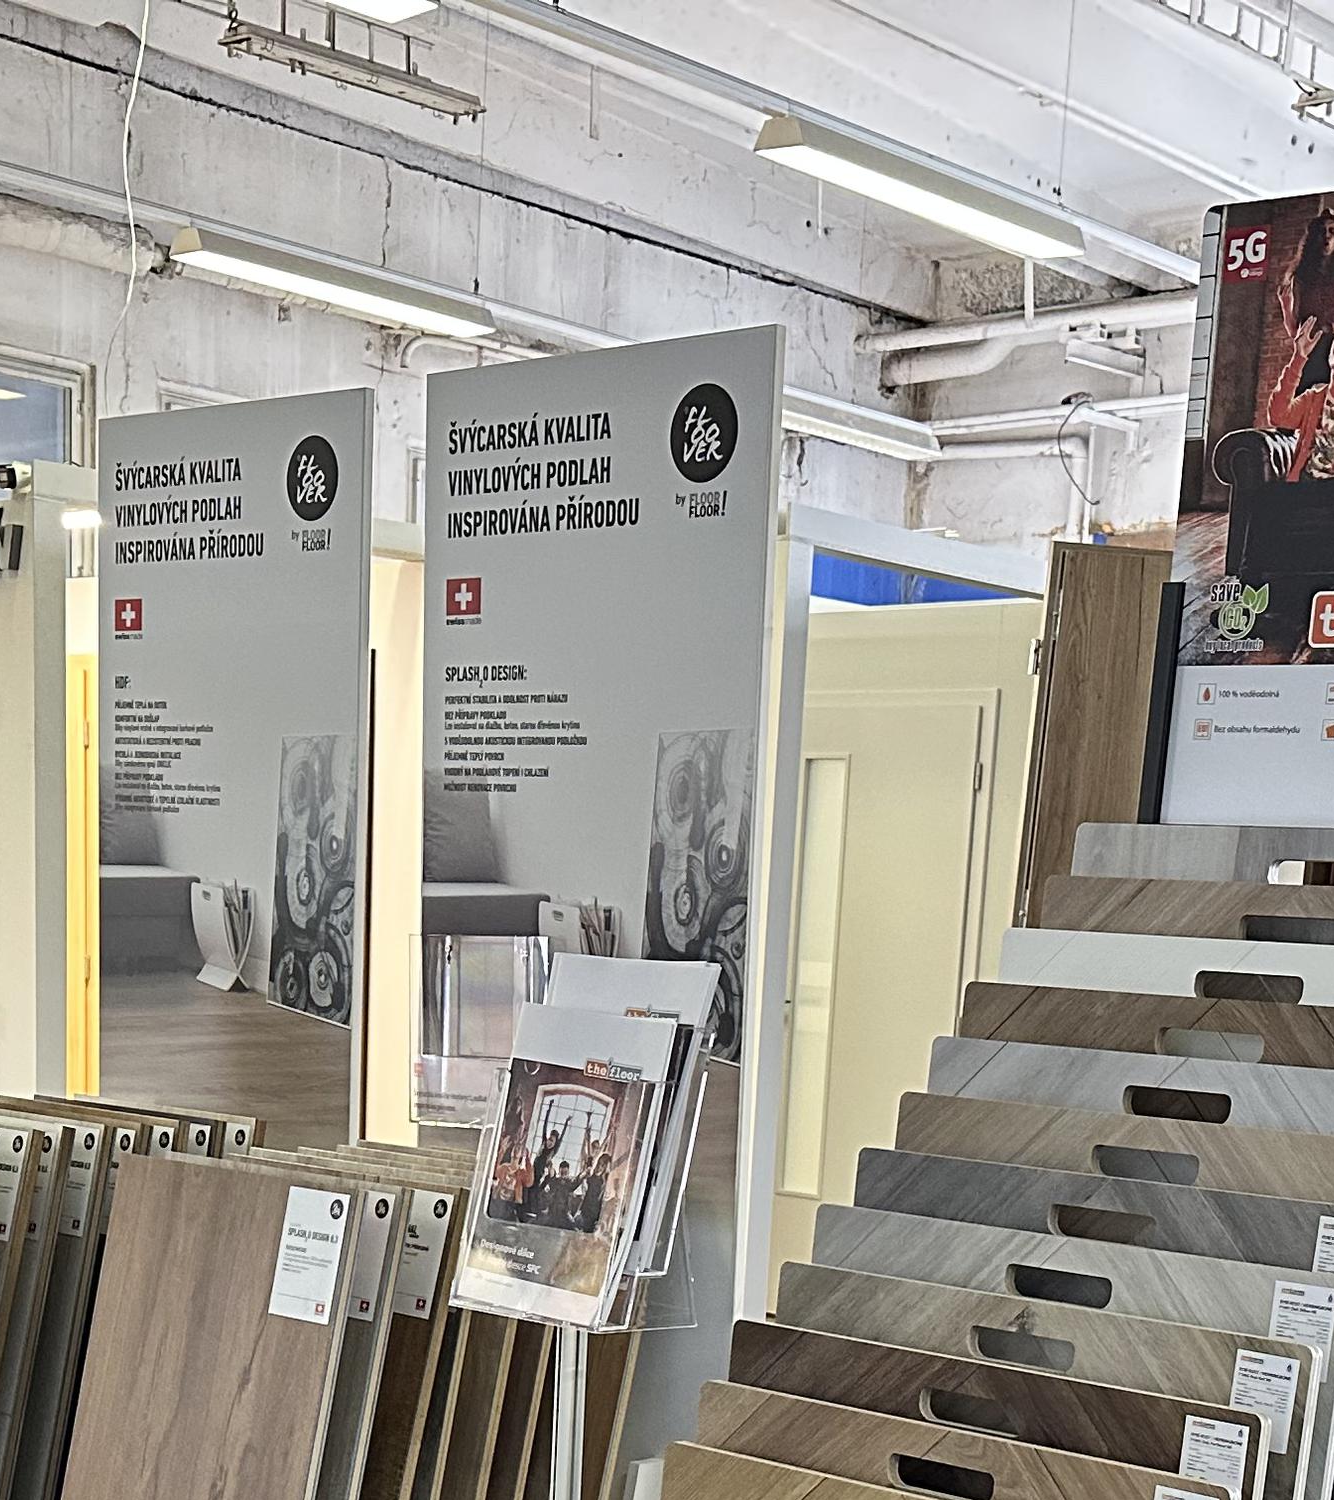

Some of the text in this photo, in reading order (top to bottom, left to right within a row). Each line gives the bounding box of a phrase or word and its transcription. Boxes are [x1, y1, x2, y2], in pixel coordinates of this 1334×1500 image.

[1227, 230, 1267, 271] 5G
[448, 411, 612, 455] ŠVÝCARSKÁ KVALITA
[114, 456, 243, 492] ŠVÝCARSKÁ KVALITA
[447, 455, 612, 497] VINYLOVÝCH PODLAH
[114, 494, 243, 528] VINYLOVÝCH PODLAH
[447, 494, 640, 539] INSPIROVÁNA PŘÍRODOU
[675, 492, 686, 507] by
[114, 529, 265, 565] INSPIROVÁNA PŘÍRODOU
[291, 530, 300, 541] by
[1210, 581, 1243, 602] save
[491, 664, 528, 681] DESIGN:
[608, 1066, 640, 1081] floor
